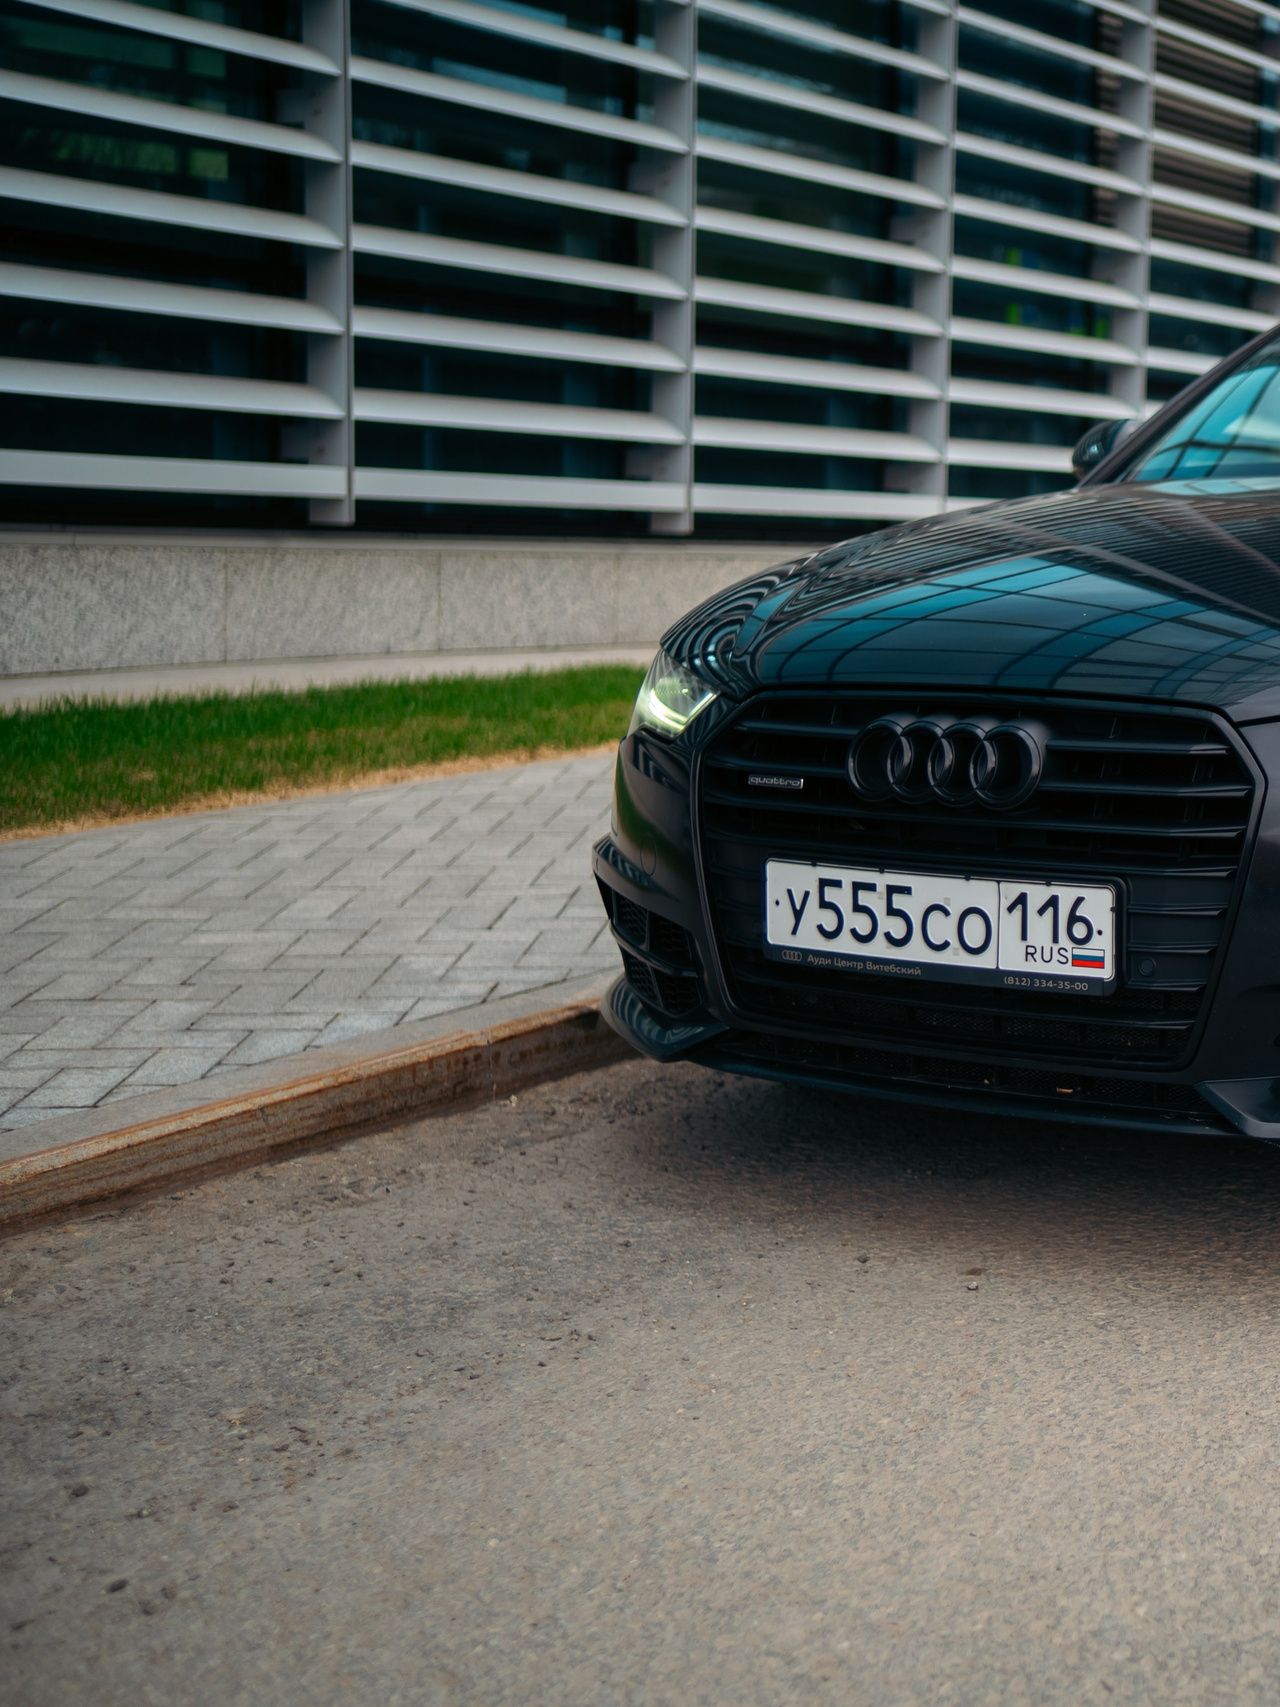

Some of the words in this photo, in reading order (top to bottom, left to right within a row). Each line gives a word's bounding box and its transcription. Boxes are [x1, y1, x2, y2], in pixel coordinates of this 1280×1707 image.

[750, 776, 801, 787] quattro
[1006, 891, 1094, 946] 116
[807, 954, 832, 966] Ауди
[834, 957, 864, 970] Центр
[866, 961, 922, 976] Витебский
[1024, 944, 1069, 965] RUS
[1004, 976, 1031, 987] (812)
[1033, 978, 1089, 991] 334-35-00
